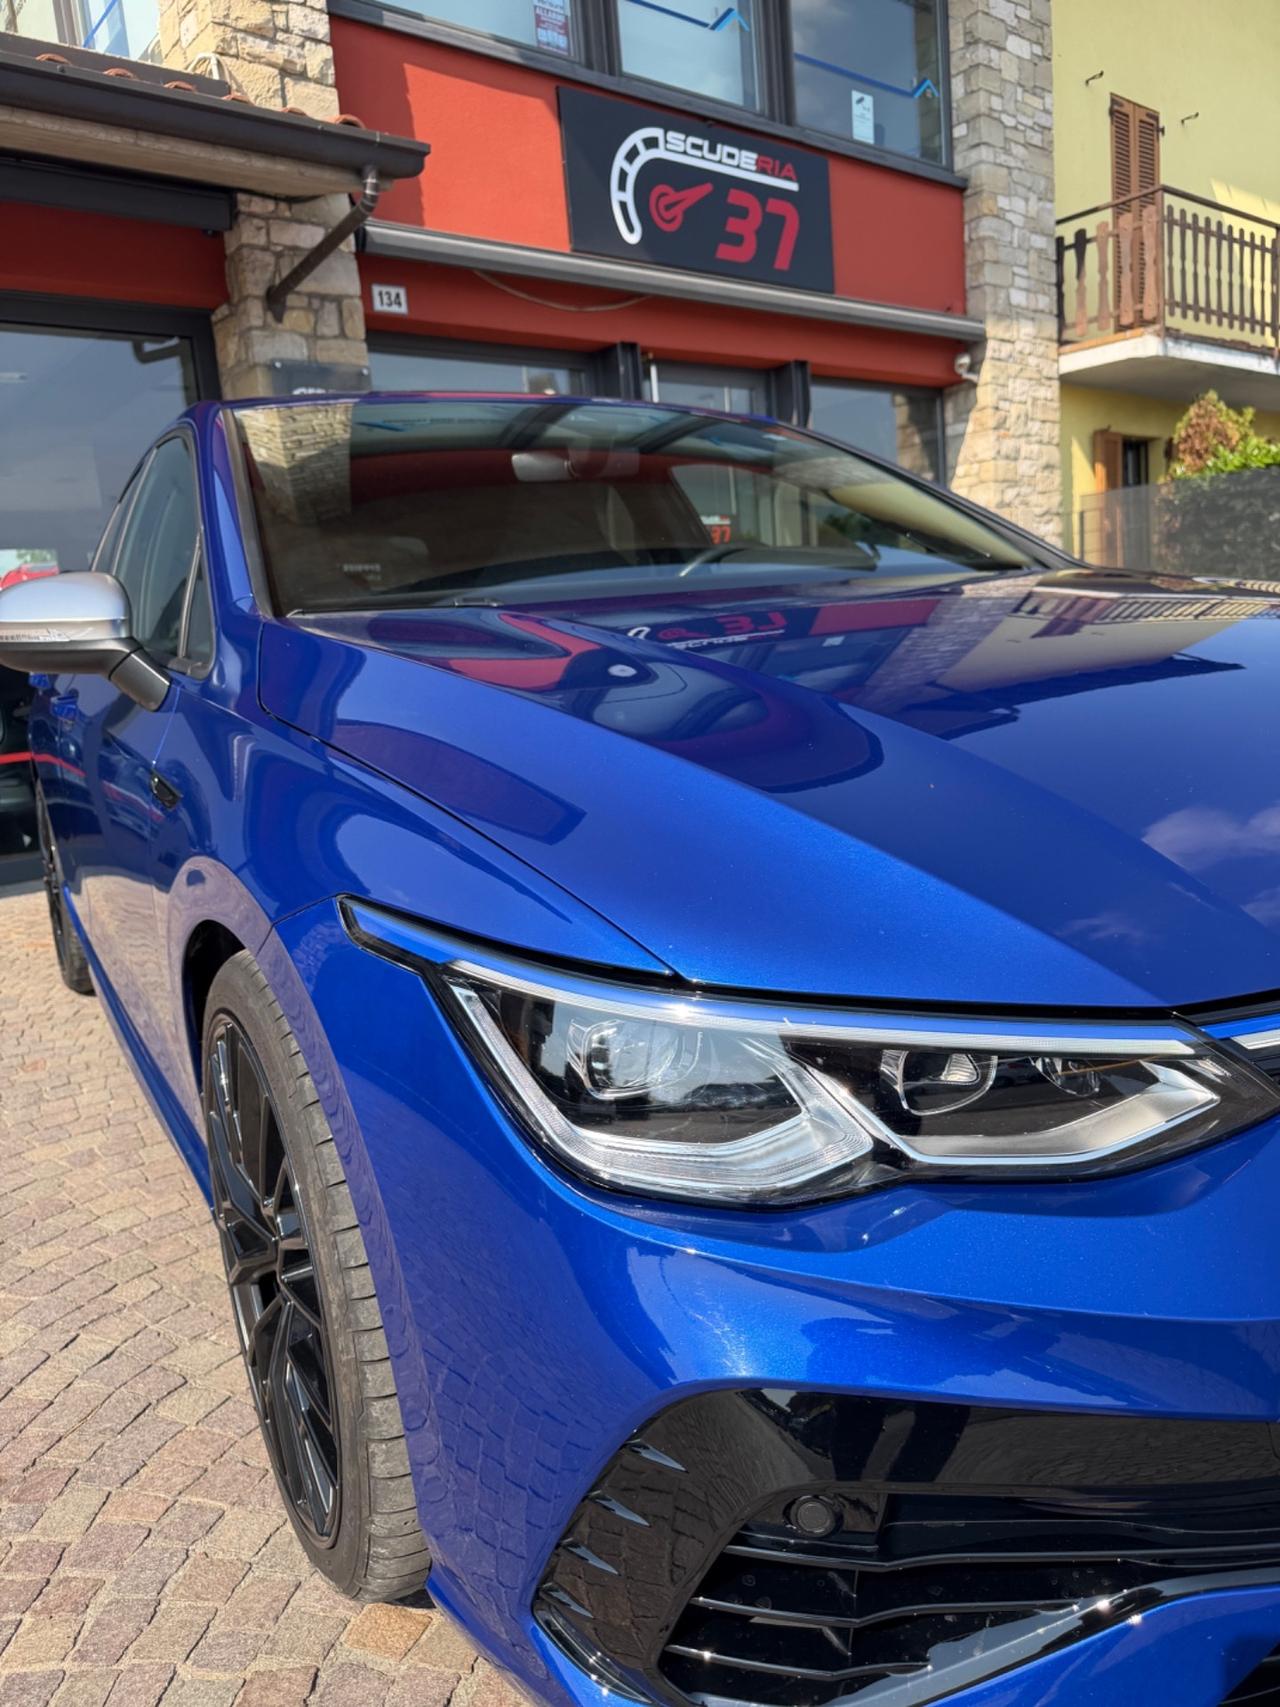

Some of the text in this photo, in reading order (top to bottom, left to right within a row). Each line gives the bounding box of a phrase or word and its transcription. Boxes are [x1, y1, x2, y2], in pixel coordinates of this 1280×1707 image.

[666, 130, 797, 181] SCUDERIA
[715, 188, 800, 271] 37
[378, 290, 402, 308] 134
